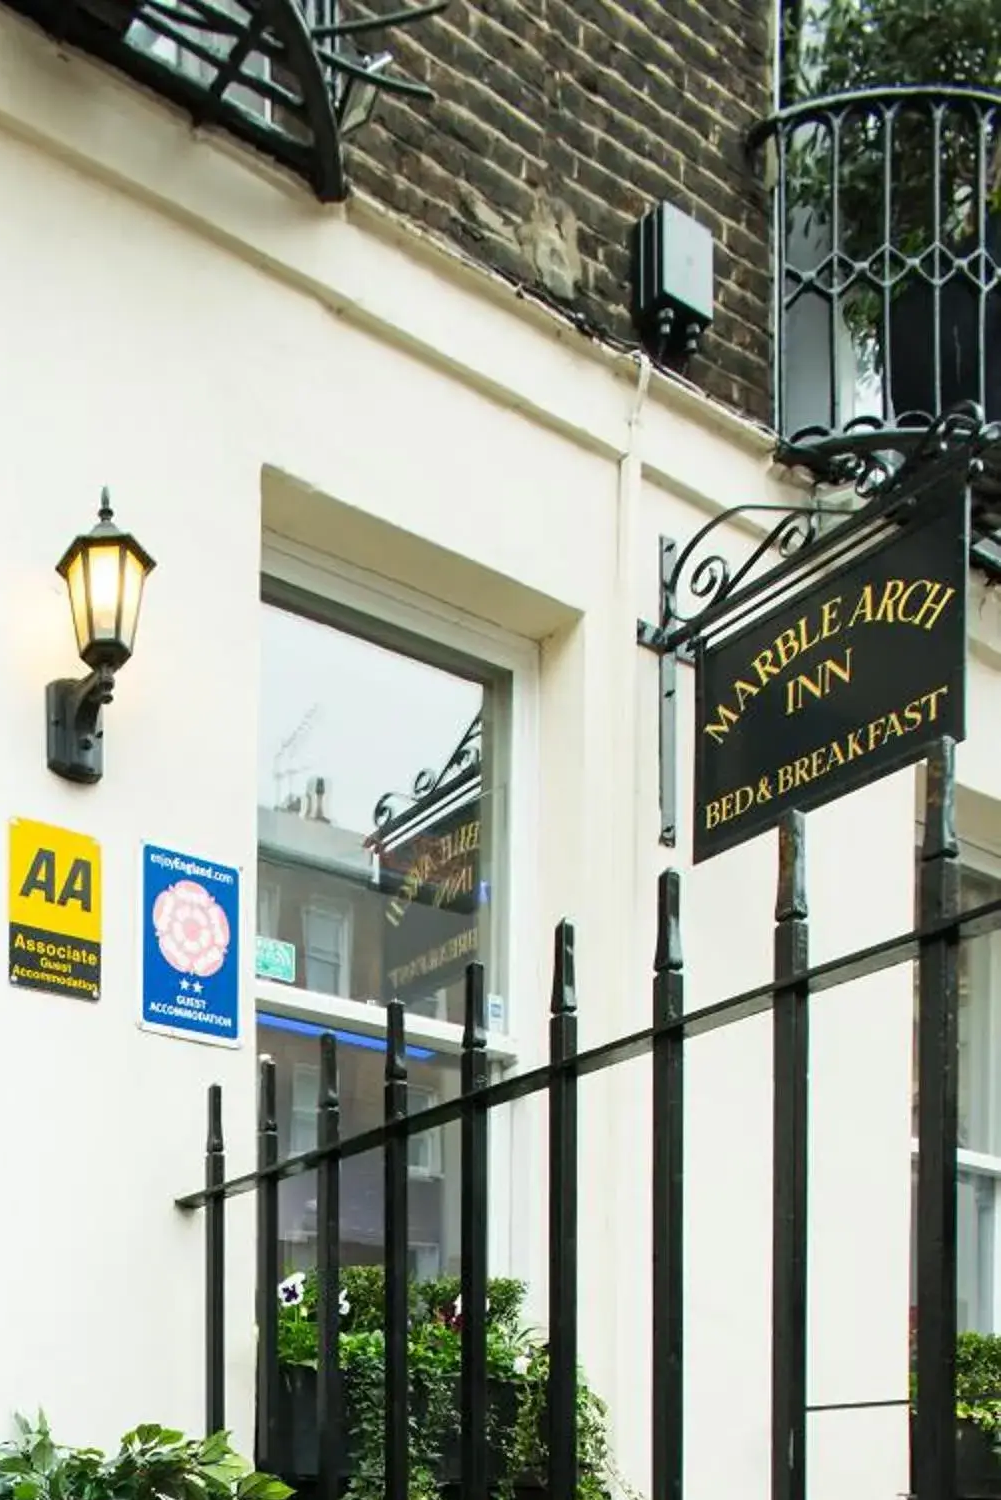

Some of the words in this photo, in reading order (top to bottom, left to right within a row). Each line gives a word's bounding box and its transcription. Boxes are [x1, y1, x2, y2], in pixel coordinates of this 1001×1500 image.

[703, 596, 843, 744] MARBLE
[849, 579, 955, 630] ARCH
[784, 648, 853, 716] INN
[777, 685, 949, 794] BREAKFAST
[19, 848, 91, 913] AA
[14, 933, 98, 966] Associate
[12, 964, 98, 992] Accommodation
[176, 994, 207, 1009] GUEST
[149, 1002, 232, 1027] ACCOMMODATION
